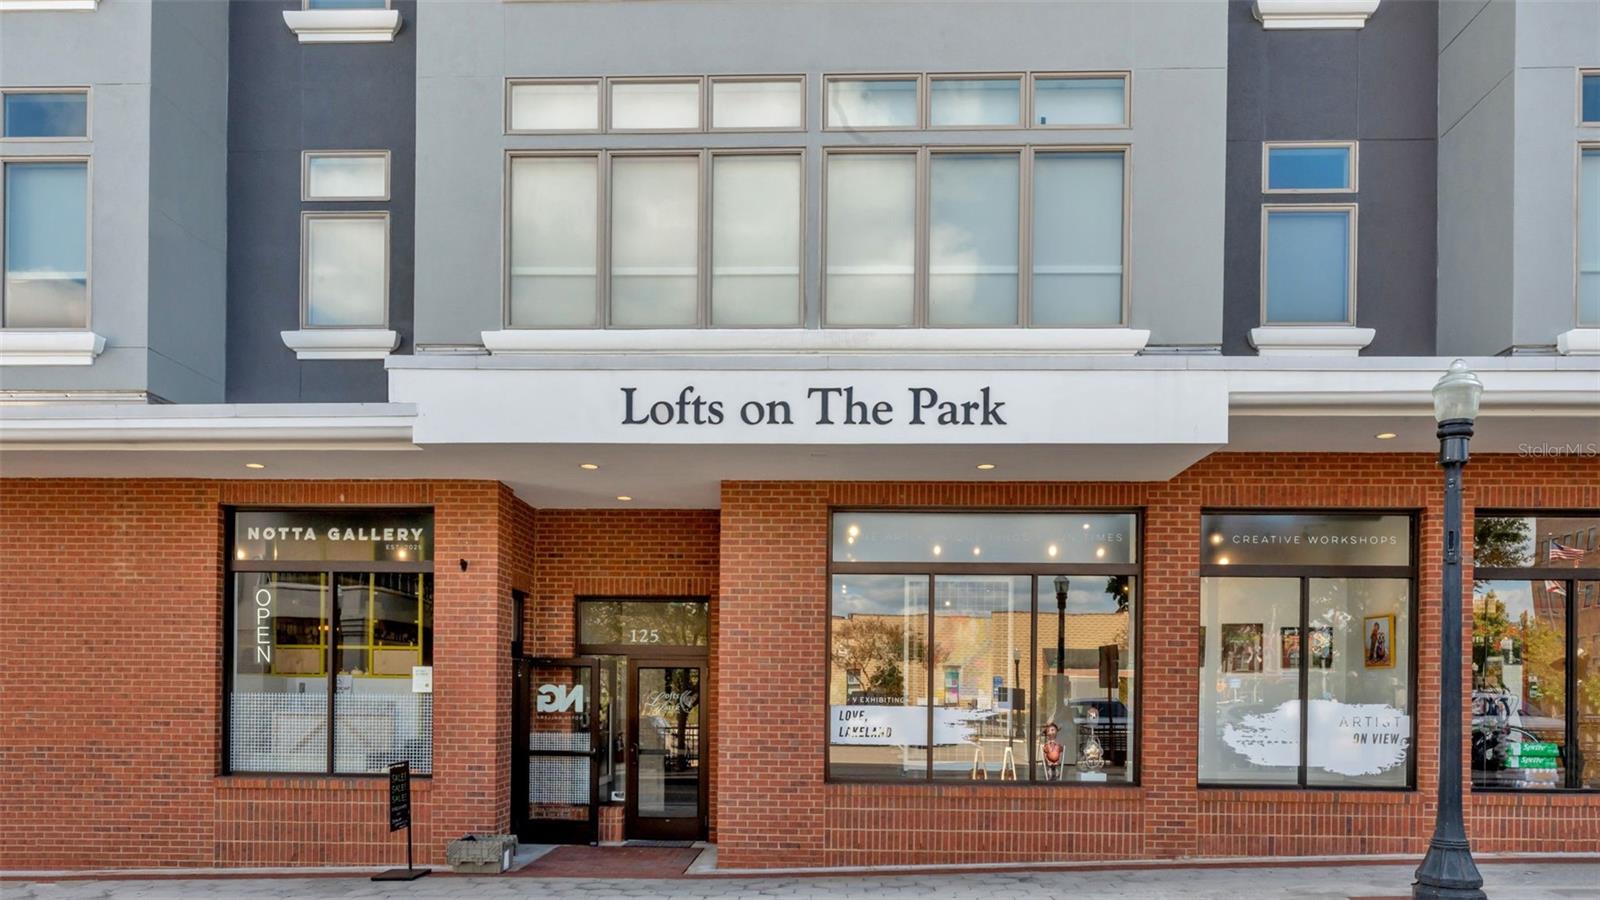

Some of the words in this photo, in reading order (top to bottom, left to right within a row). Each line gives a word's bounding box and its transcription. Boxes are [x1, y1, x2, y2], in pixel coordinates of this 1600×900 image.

[620, 385, 725, 426] Lofts
[739, 399, 795, 426] on
[806, 385, 894, 426] The
[907, 385, 1008, 426] Park
[327, 527, 424, 541] GALLERY
[1232, 535, 1301, 545] CREATIVE
[1308, 535, 1397, 545] WORKSHOPS
[255, 588, 271, 663] OPEN
[630, 629, 660, 643] 125
[860, 696, 905, 704] EXHIBITING
[839, 710, 868, 722] LOVE,
[1353, 732, 1368, 745] ON
[1372, 732, 1400, 745] VIEW
